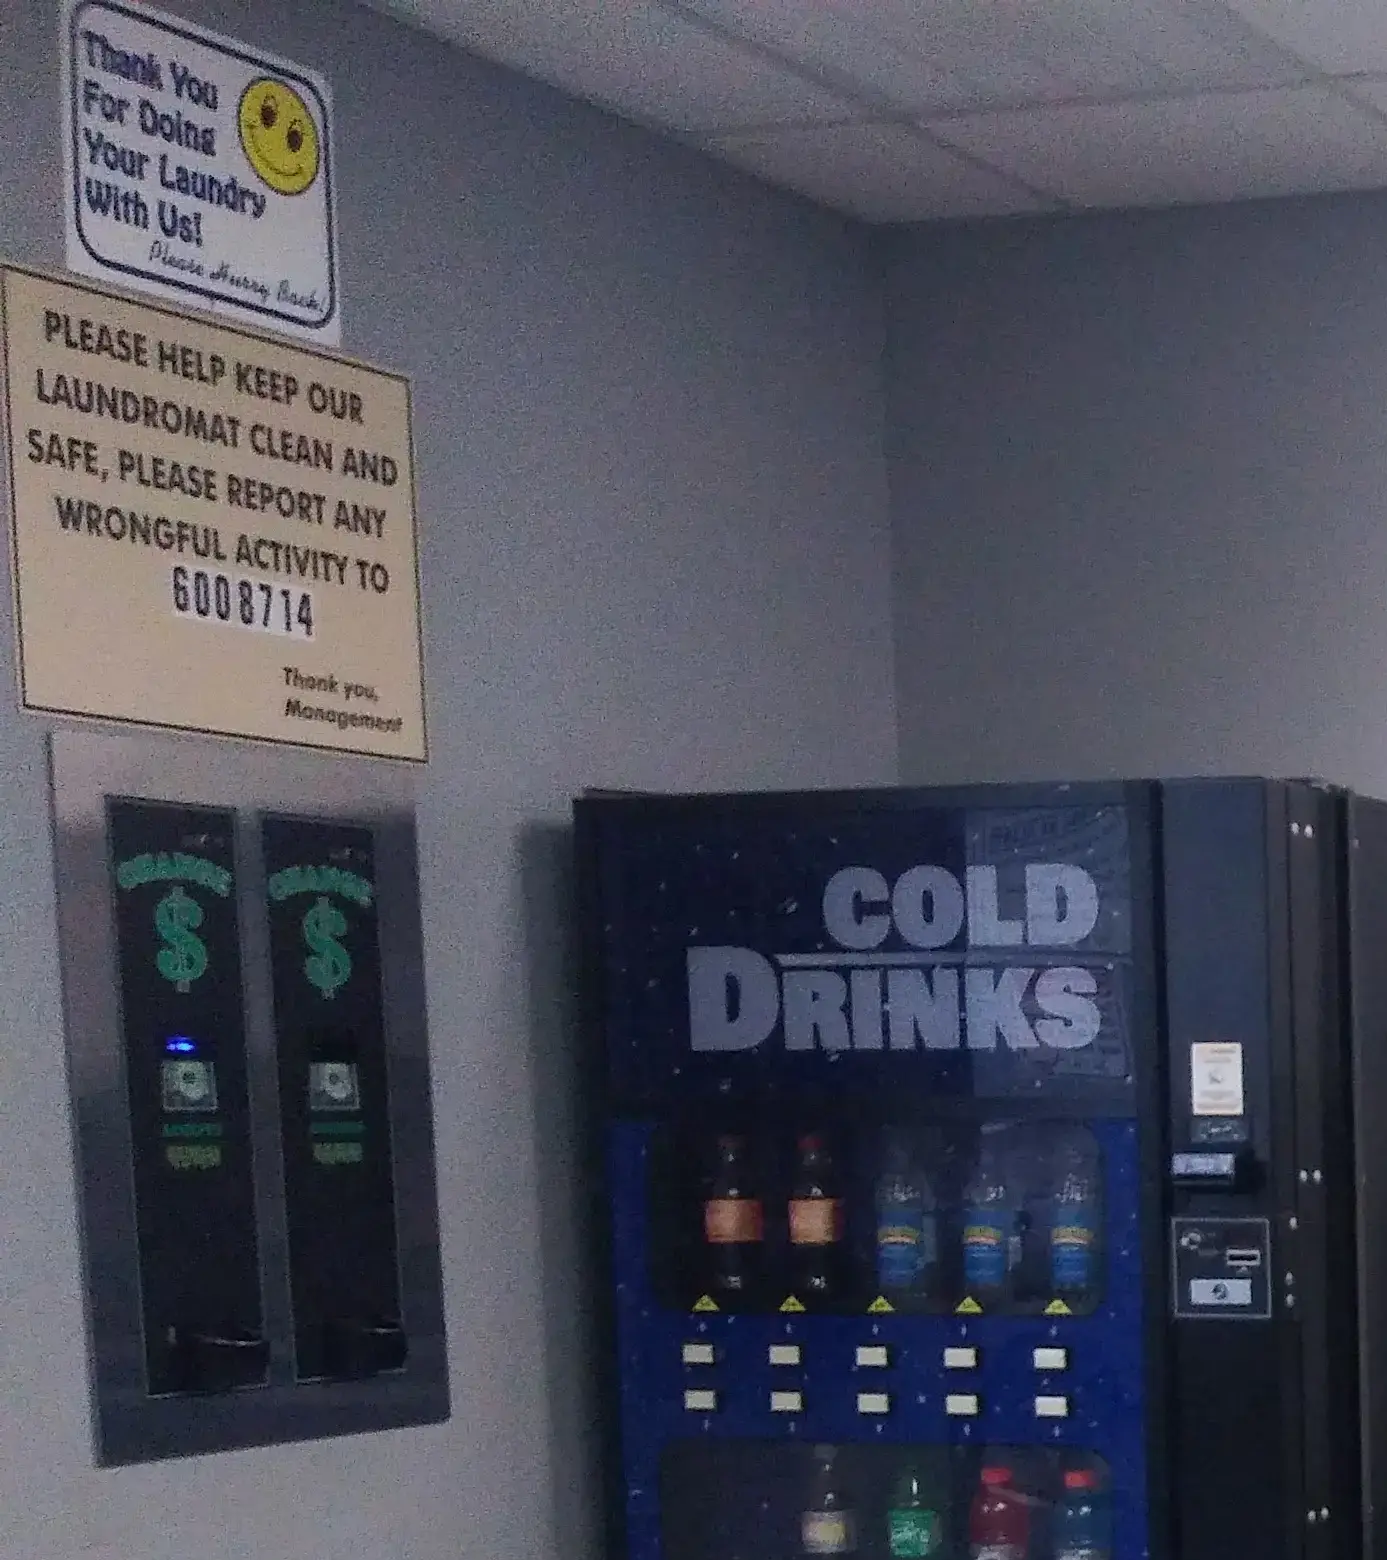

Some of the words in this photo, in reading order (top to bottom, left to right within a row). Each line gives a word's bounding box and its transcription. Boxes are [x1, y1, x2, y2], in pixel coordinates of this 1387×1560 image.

[81, 30, 164, 91] Thank
[170, 61, 218, 110] You
[84, 79, 130, 126] For
[139, 100, 216, 156] Doing
[84, 127, 149, 180] Your
[160, 155, 266, 218] Laundry
[86, 177, 149, 230] With
[158, 200, 203, 248] Us!
[44, 307, 148, 367] PLEASE
[158, 341, 225, 387] HELP
[236, 362, 297, 404] KEEP
[308, 382, 363, 424] OUR
[36, 368, 240, 448] LAUNDROMAT
[250, 424, 332, 472] CLEAN
[342, 448, 398, 487] AND
[27, 429, 109, 482] SAFE,
[119, 449, 216, 501] PLEASE
[228, 474, 326, 525] REPORT
[333, 503, 387, 540] ANY
[55, 495, 227, 563] WRONGFUL
[236, 534, 348, 586] ACTIVITY
[356, 560, 390, 595] TO
[283, 666, 339, 692] Thank
[285, 698, 403, 733] Management
[821, 863, 1100, 950] COLD
[686, 945, 1101, 1052] DRINKS
